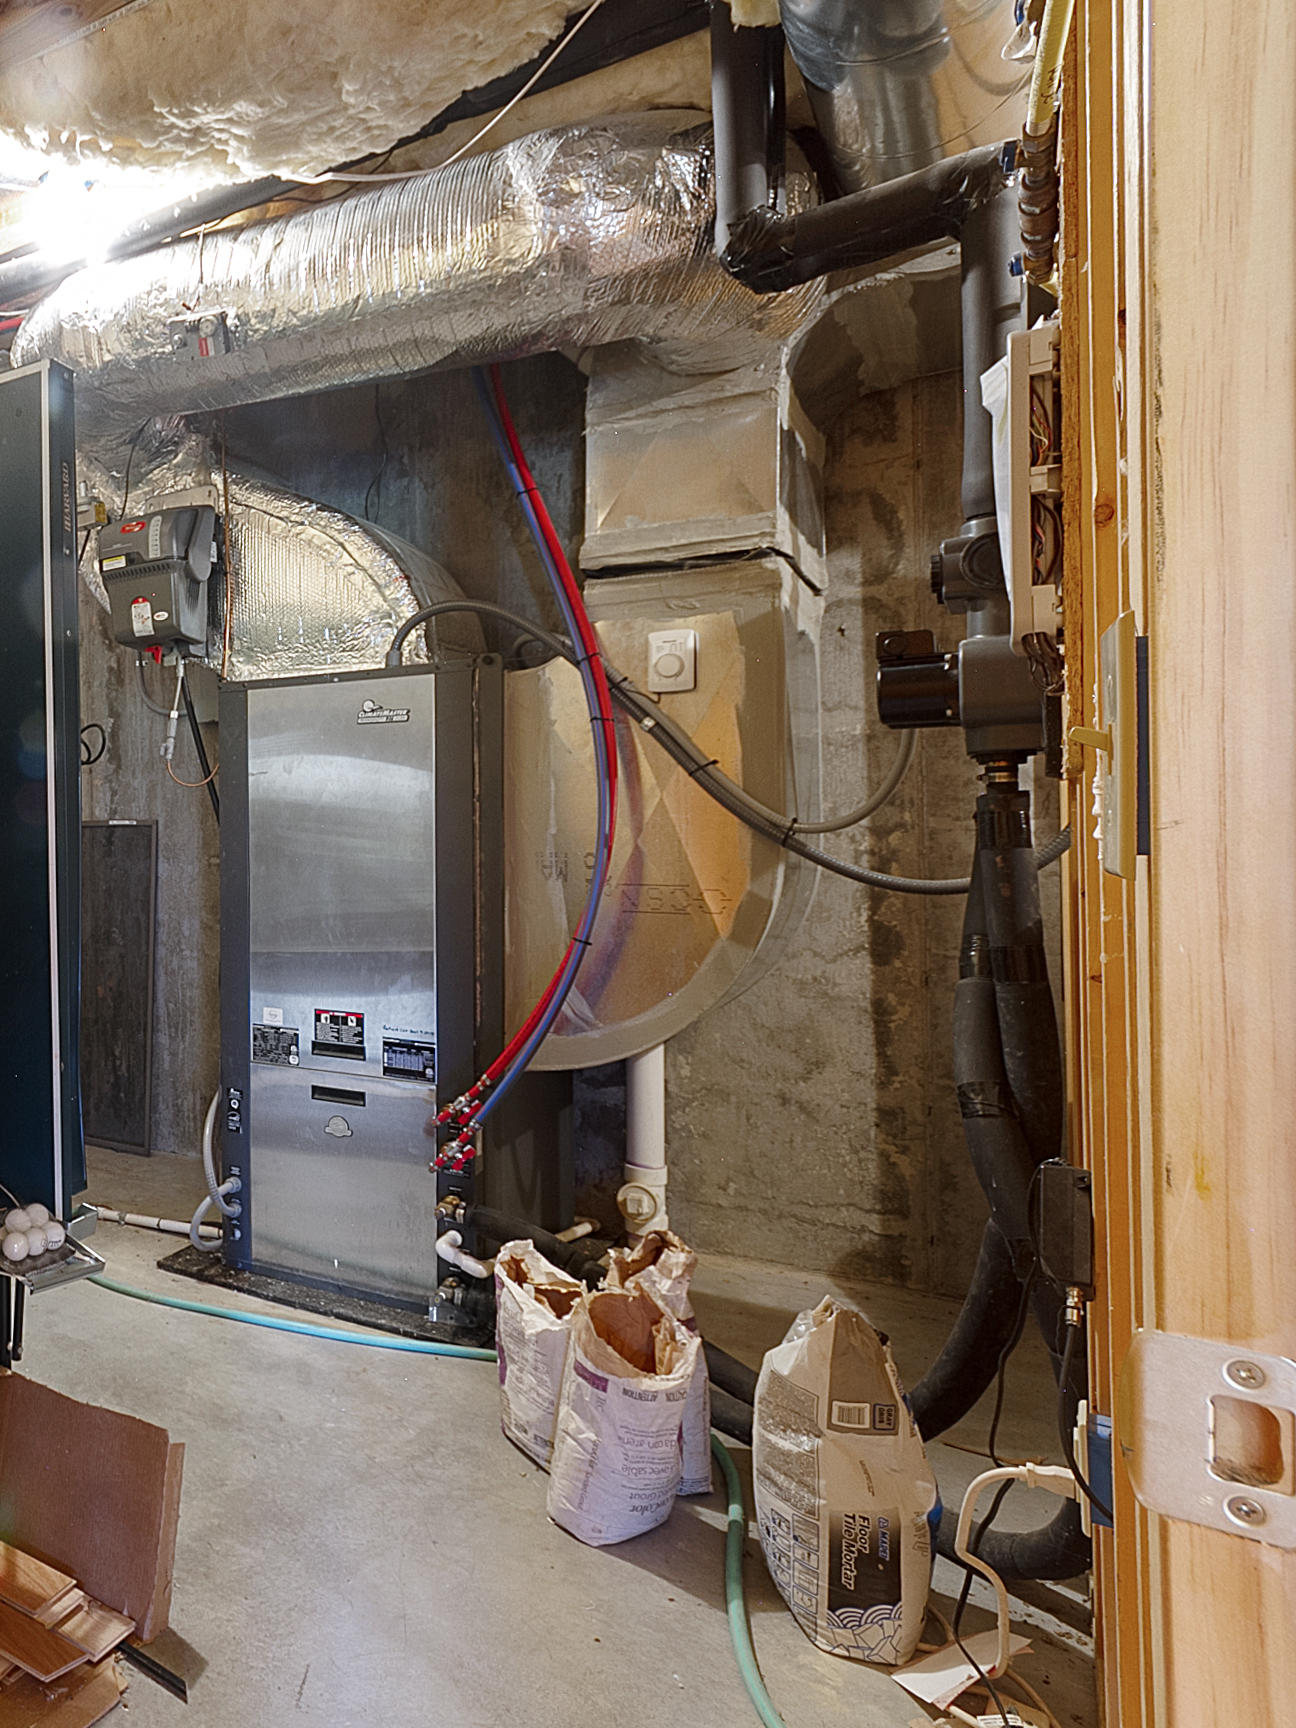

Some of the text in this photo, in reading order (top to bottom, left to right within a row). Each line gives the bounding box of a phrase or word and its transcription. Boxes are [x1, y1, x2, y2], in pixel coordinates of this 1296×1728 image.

[885, 1407, 894, 1426] GRAY
[841, 1513, 857, 1590] Tile Mortar
[857, 1514, 872, 1554] Floor
[878, 1530, 890, 1561] MAPEI
